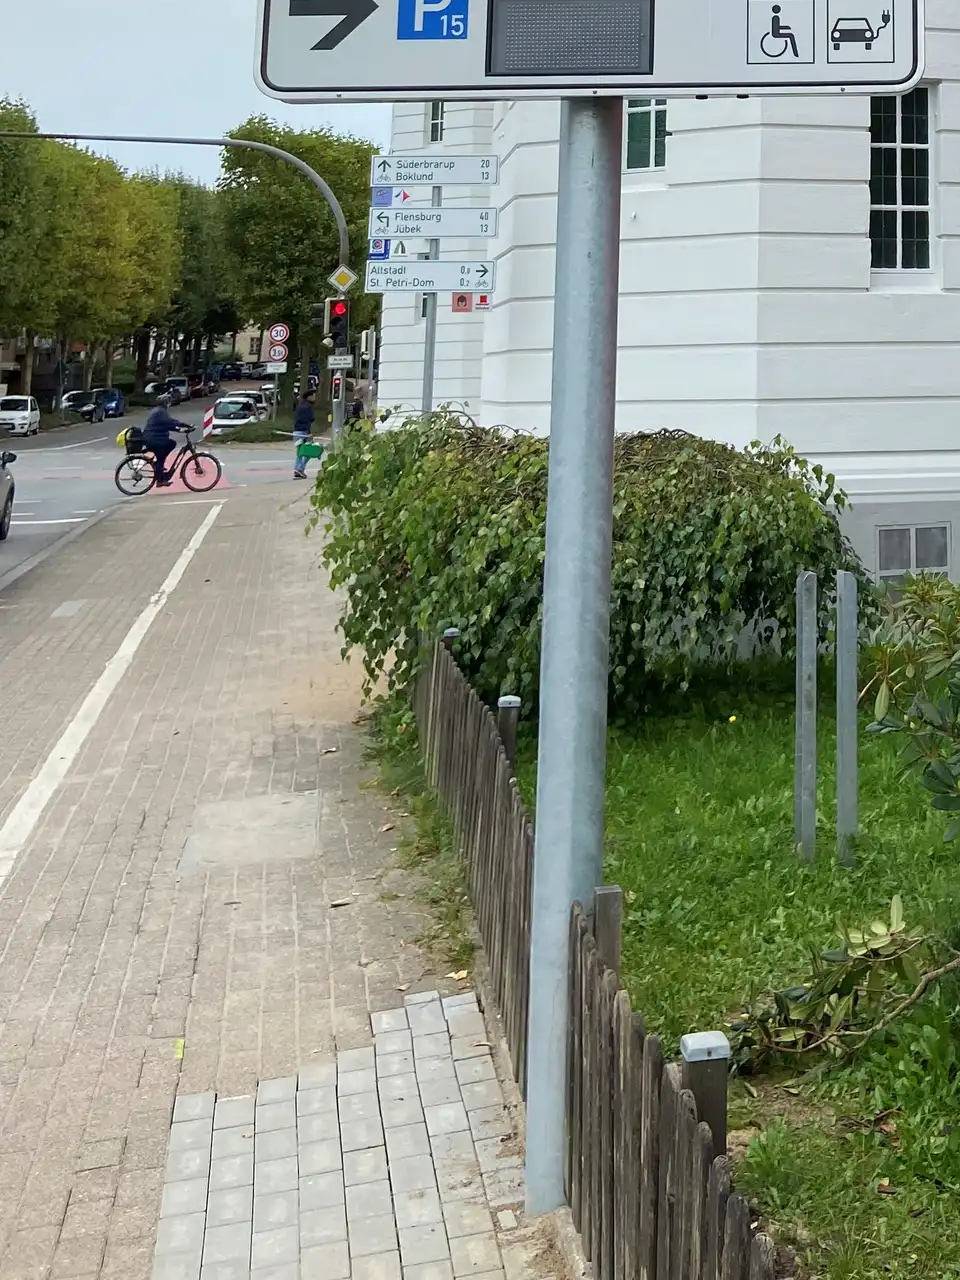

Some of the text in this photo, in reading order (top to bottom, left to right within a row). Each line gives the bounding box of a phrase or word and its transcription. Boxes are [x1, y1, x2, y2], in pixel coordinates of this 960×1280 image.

[440, 15, 465, 37] 15
[396, 159, 490, 170] Süderbrarup 20
[396, 171, 490, 181] Böklund 13
[395, 212, 489, 223] Flensburg 40
[394, 224, 489, 234] Jübek 13
[370, 265, 407, 275] Altstadt
[386, 278, 435, 288] Petri-Dom
[273, 329, 285, 338] 30
